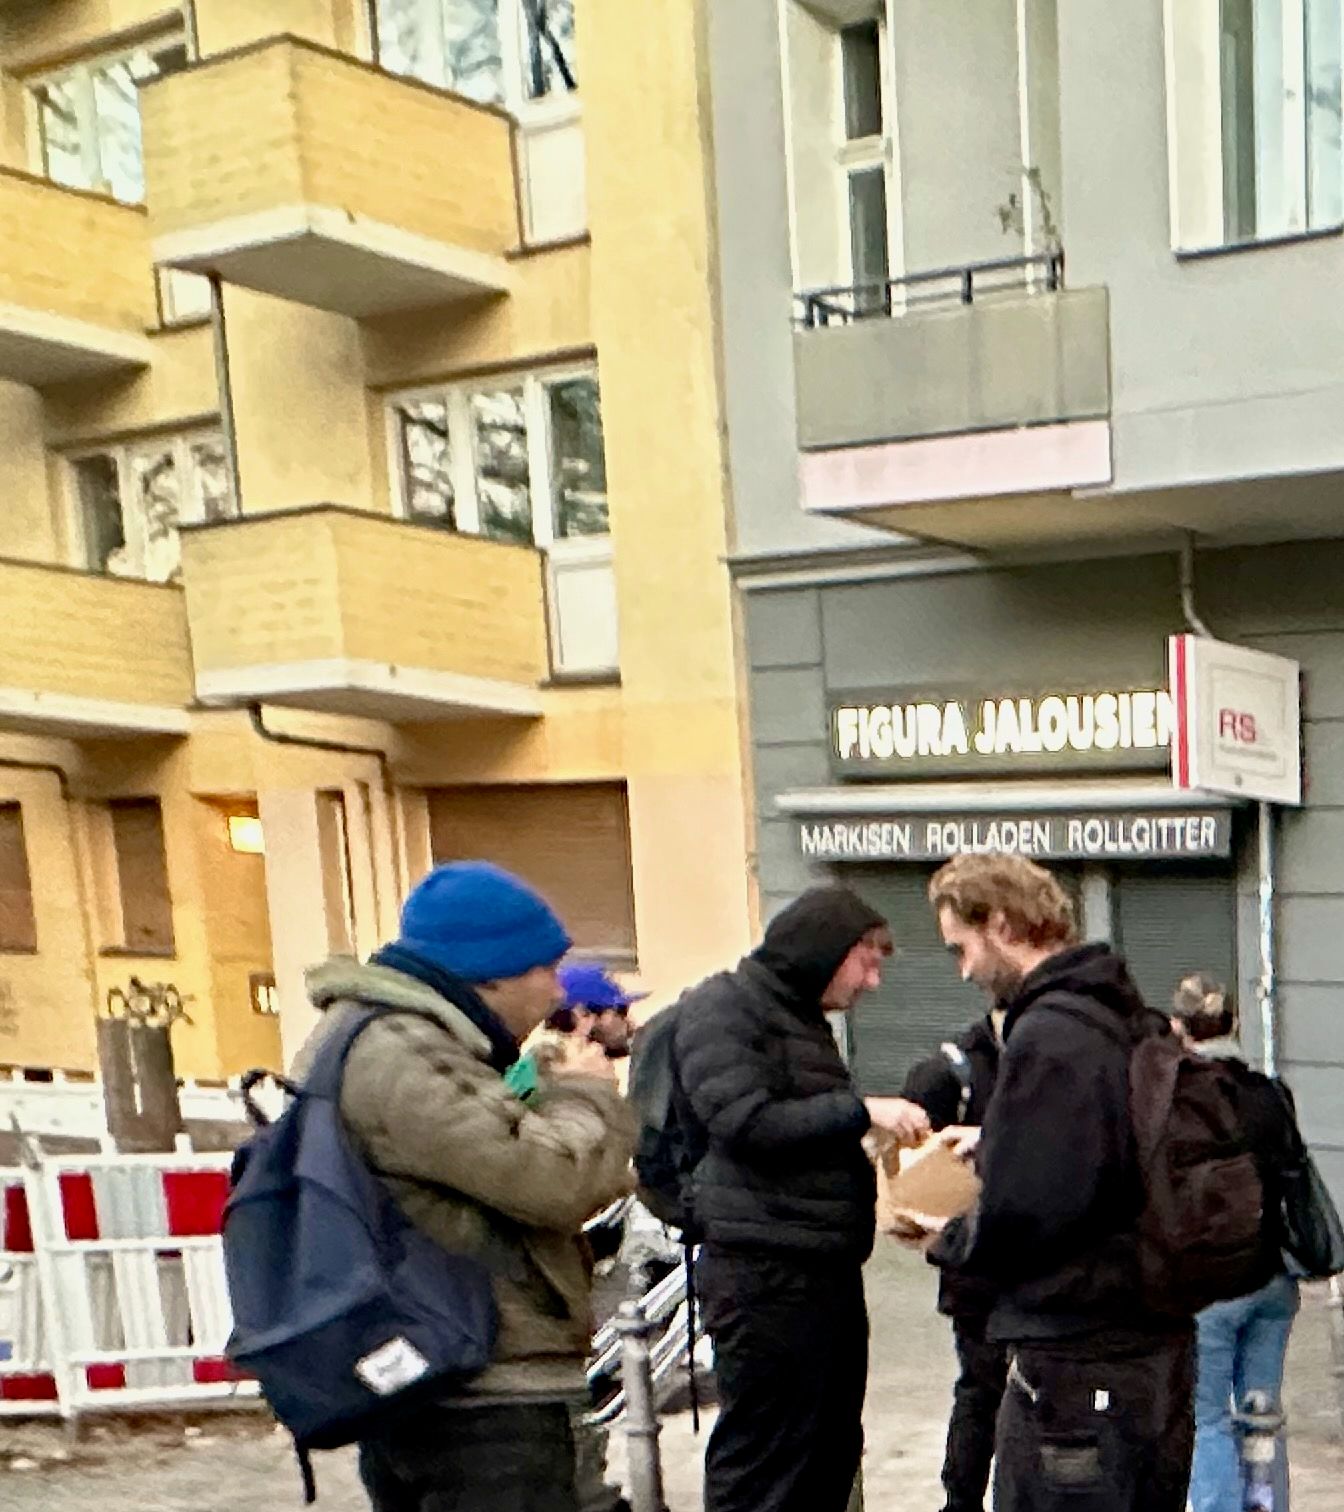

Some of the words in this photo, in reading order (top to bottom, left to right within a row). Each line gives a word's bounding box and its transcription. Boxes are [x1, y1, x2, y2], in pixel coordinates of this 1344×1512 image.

[836, 701, 968, 759] FIGURA
[1219, 708, 1257, 743] RS
[800, 822, 911, 855] MARKISEN
[926, 820, 1051, 854] ROLLADEN
[1067, 815, 1216, 852] ROLLGITTER
